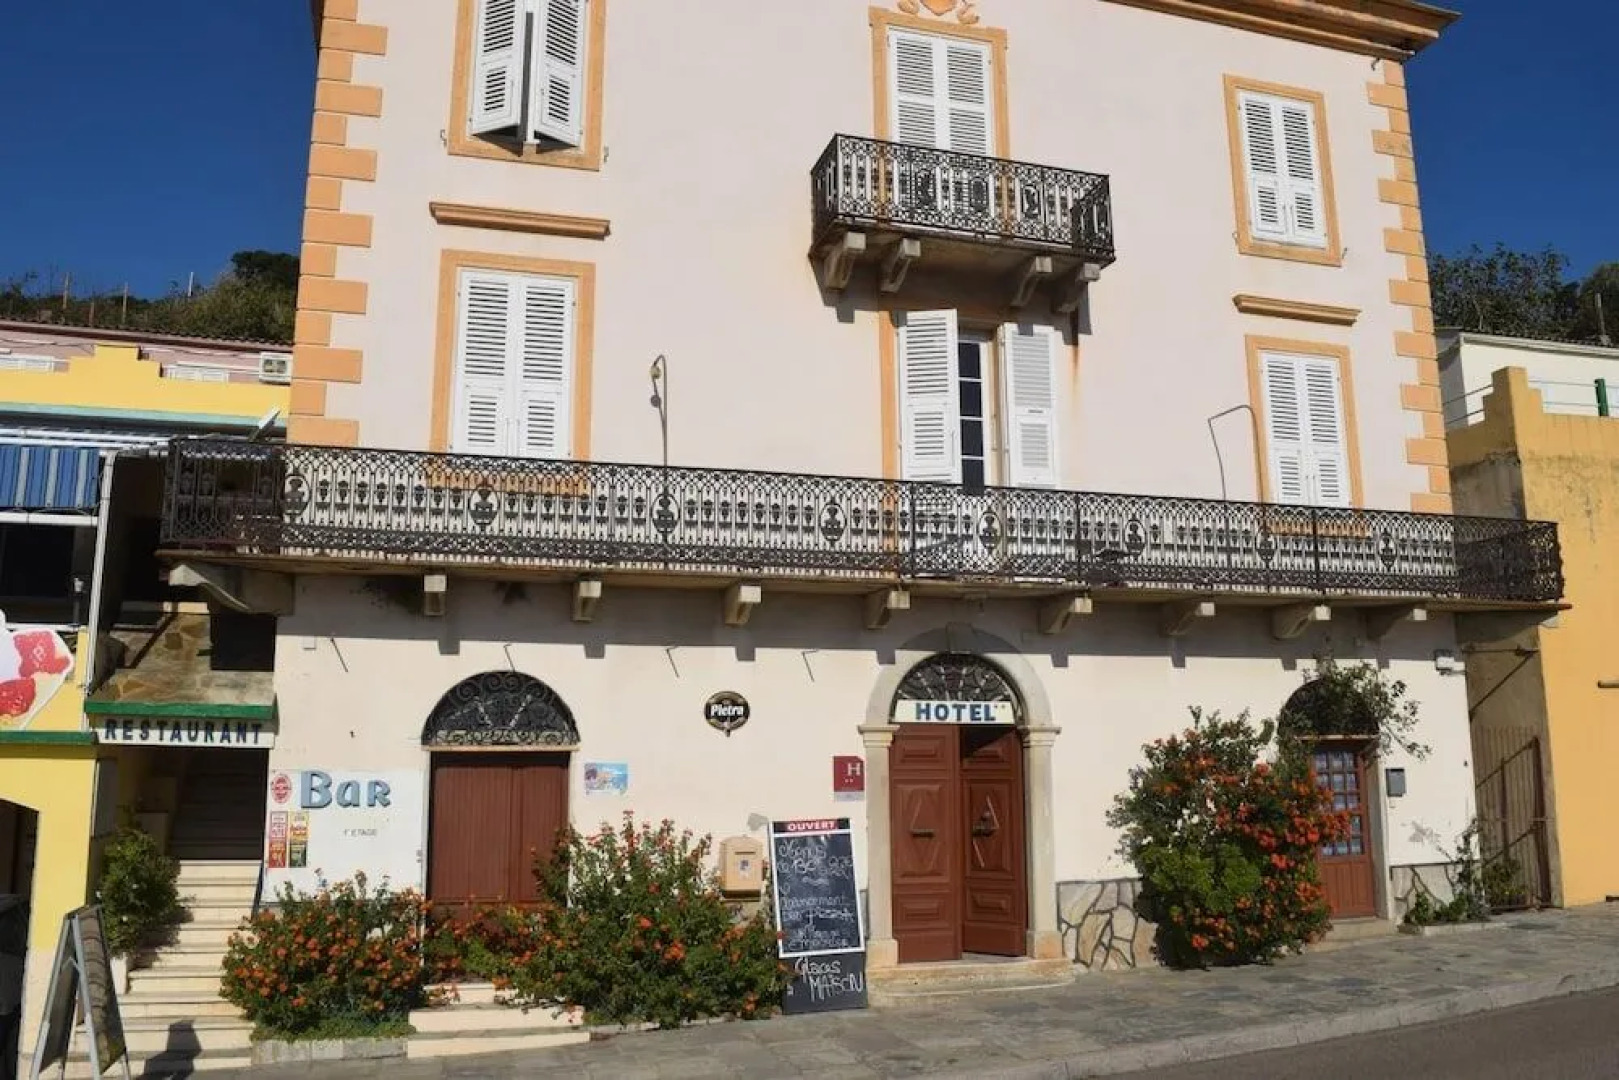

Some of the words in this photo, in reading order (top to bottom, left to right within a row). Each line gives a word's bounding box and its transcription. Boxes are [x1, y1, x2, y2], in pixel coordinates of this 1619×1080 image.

[710, 703, 744, 717] Pietra
[915, 702, 996, 722] HOTEL
[104, 718, 263, 745] RESTAURANT
[847, 762, 861, 776] H
[787, 820, 836, 832] OUVERT
